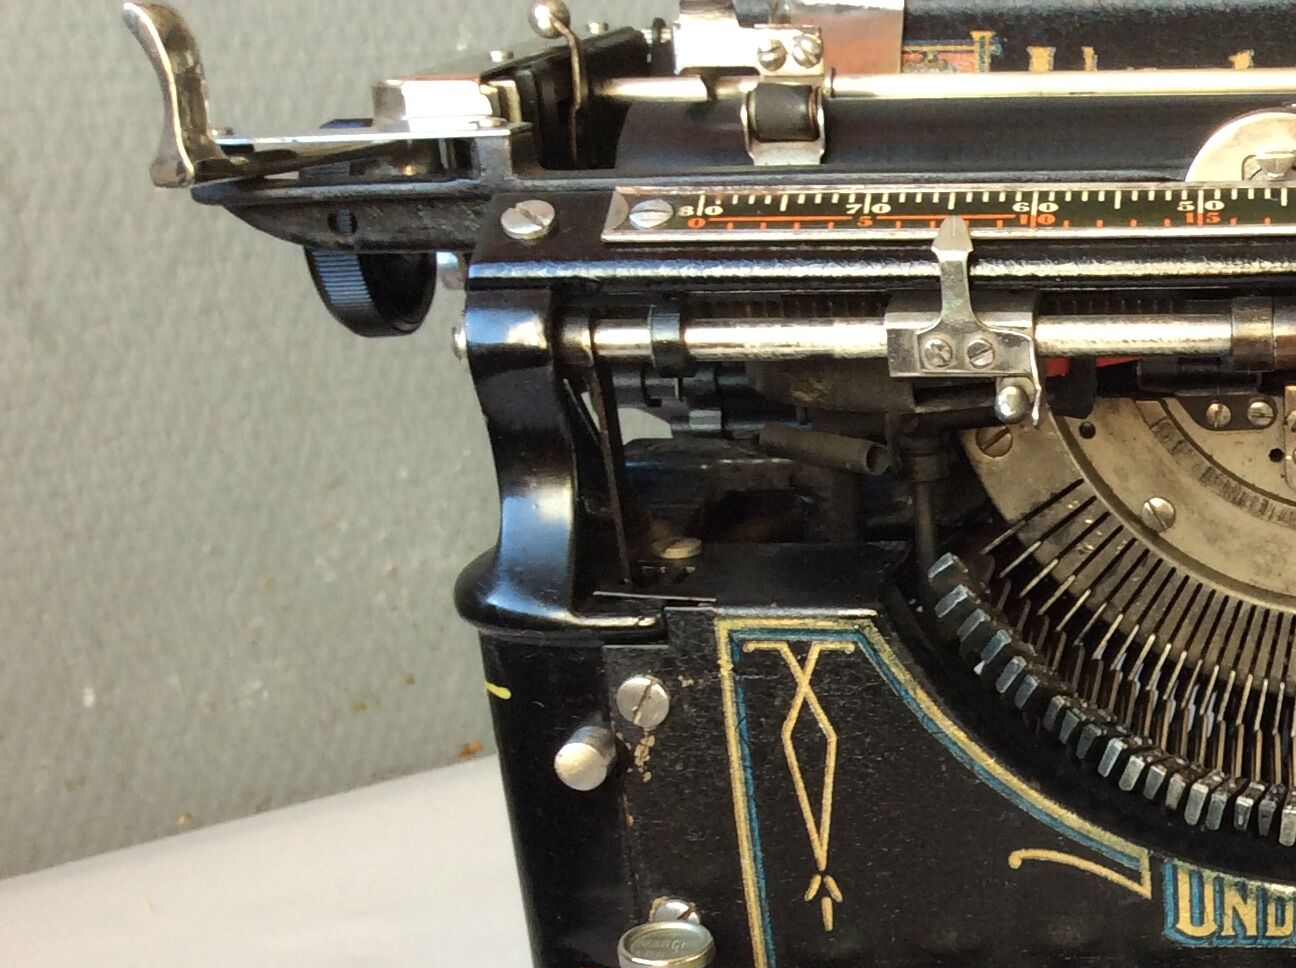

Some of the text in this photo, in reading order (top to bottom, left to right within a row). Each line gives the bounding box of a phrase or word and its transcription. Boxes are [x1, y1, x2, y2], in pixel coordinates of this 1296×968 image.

[679, 203, 723, 216] 80
[846, 202, 892, 215] 70
[1012, 201, 1059, 213] 60
[1177, 200, 1225, 212] 50
[687, 217, 706, 228] 0
[857, 215, 873, 227] 5
[1019, 213, 1056, 227] 10
[1186, 212, 1221, 225] 15
